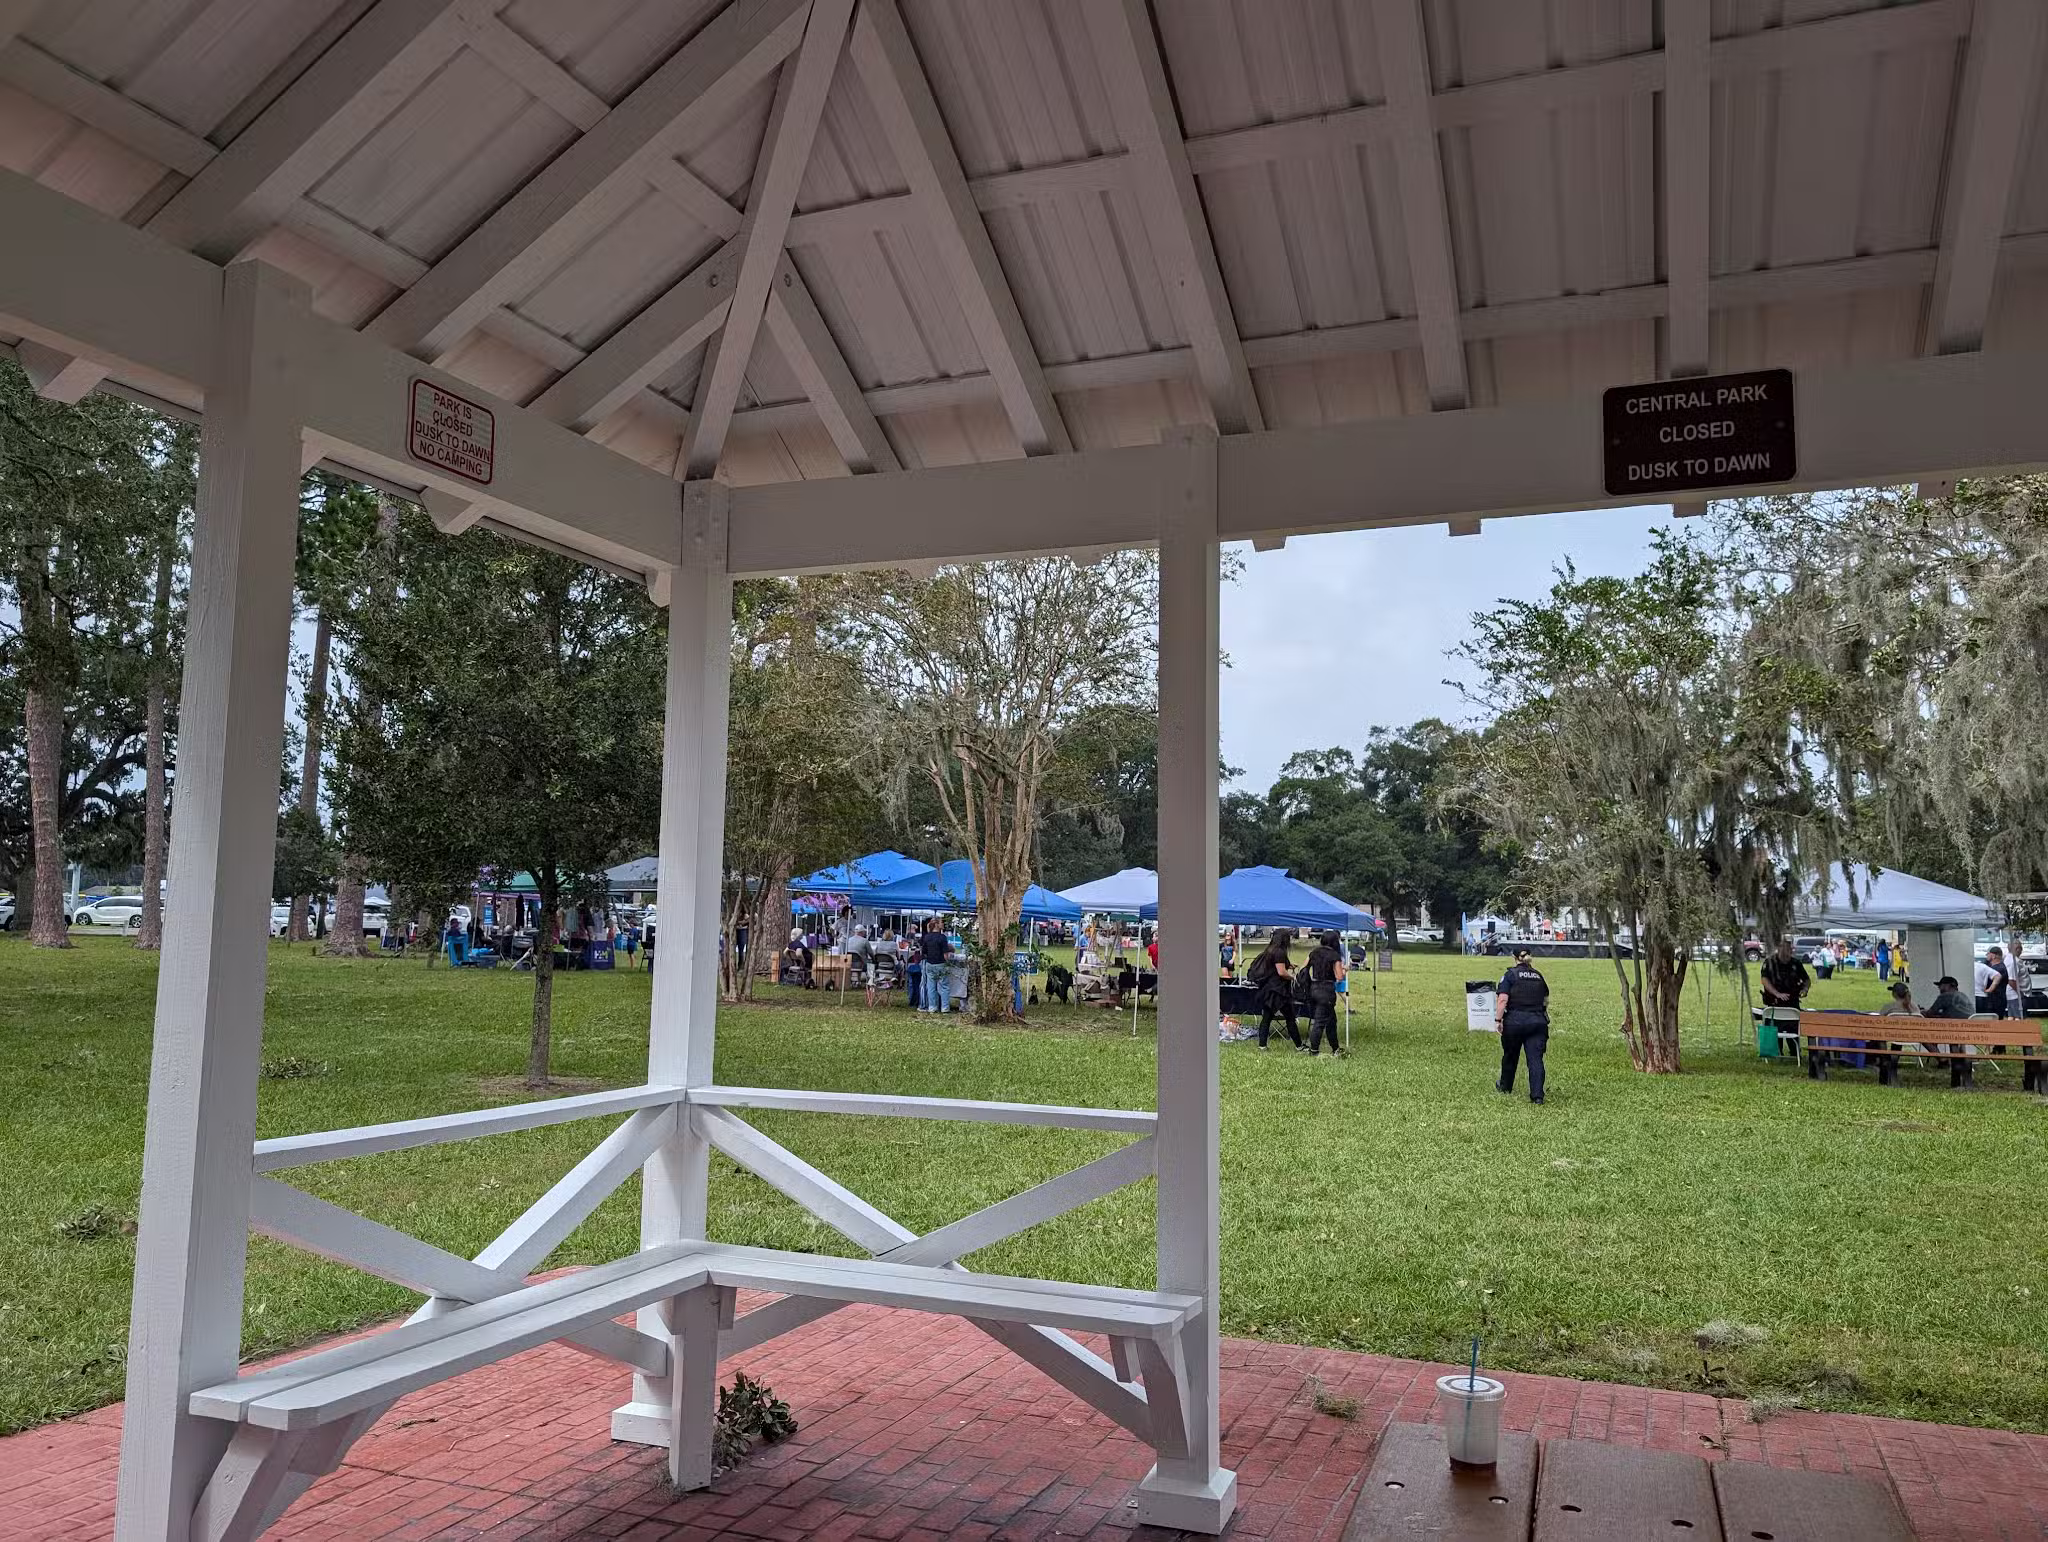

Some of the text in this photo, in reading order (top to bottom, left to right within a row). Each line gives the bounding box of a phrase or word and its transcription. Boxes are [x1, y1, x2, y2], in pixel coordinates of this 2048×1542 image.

[433, 393, 472, 419] PARK IS
[1626, 384, 1768, 414] CENTRAL PARK
[433, 410, 473, 437] CLOSED
[1659, 420, 1735, 443] CLOSED
[415, 420, 490, 461] DUSK TO DAWN
[419, 440, 483, 475] NO CAMPING
[1628, 452, 1771, 480] DUSK TO DAWN
[1519, 971, 1540, 979] POLICE
